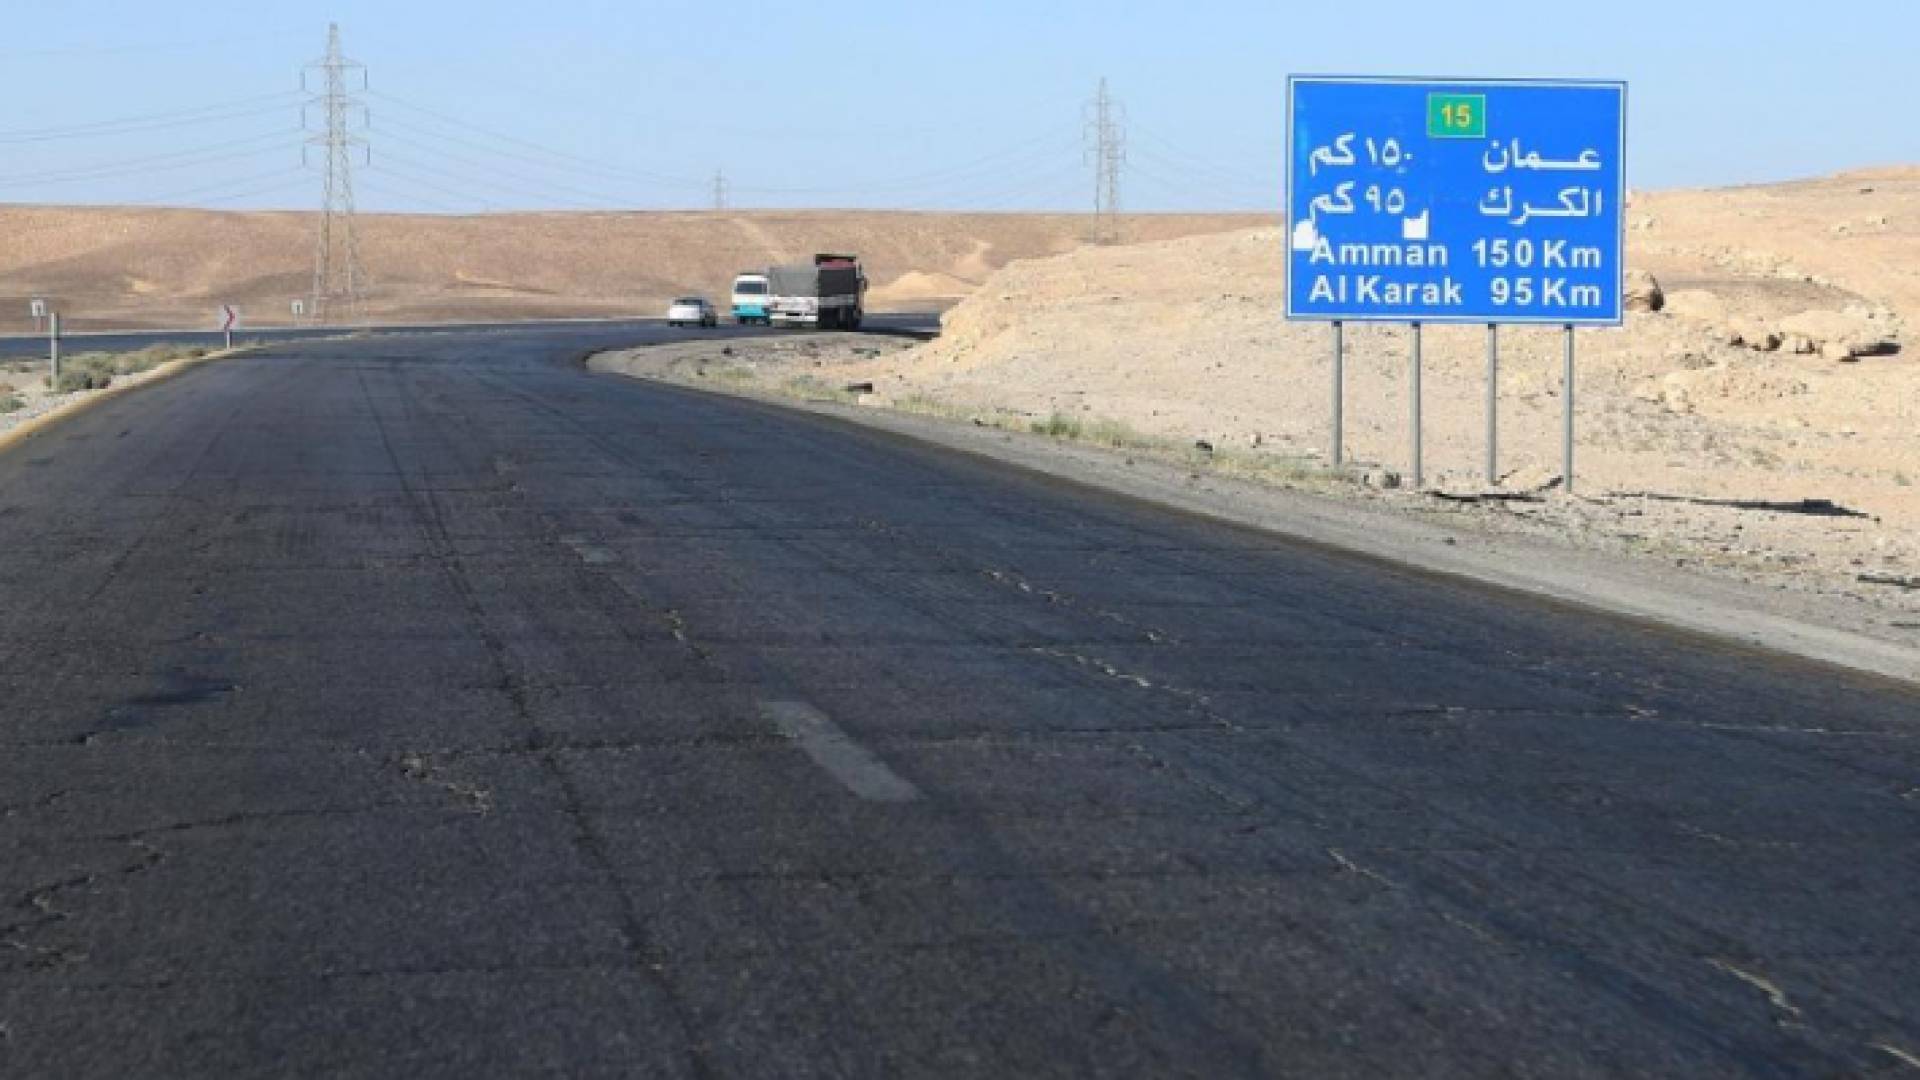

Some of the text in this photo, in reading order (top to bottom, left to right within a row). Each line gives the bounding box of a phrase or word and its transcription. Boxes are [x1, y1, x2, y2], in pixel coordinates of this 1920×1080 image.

[1441, 104, 1472, 128] 15
[1309, 132, 1601, 177] عمان ١٥٠ كم
[1309, 180, 1602, 226] الكرك ٩٥ كم
[1309, 236, 1601, 268] Amman 150 Km
[1309, 274, 1601, 307] Al Karak 95 Km
